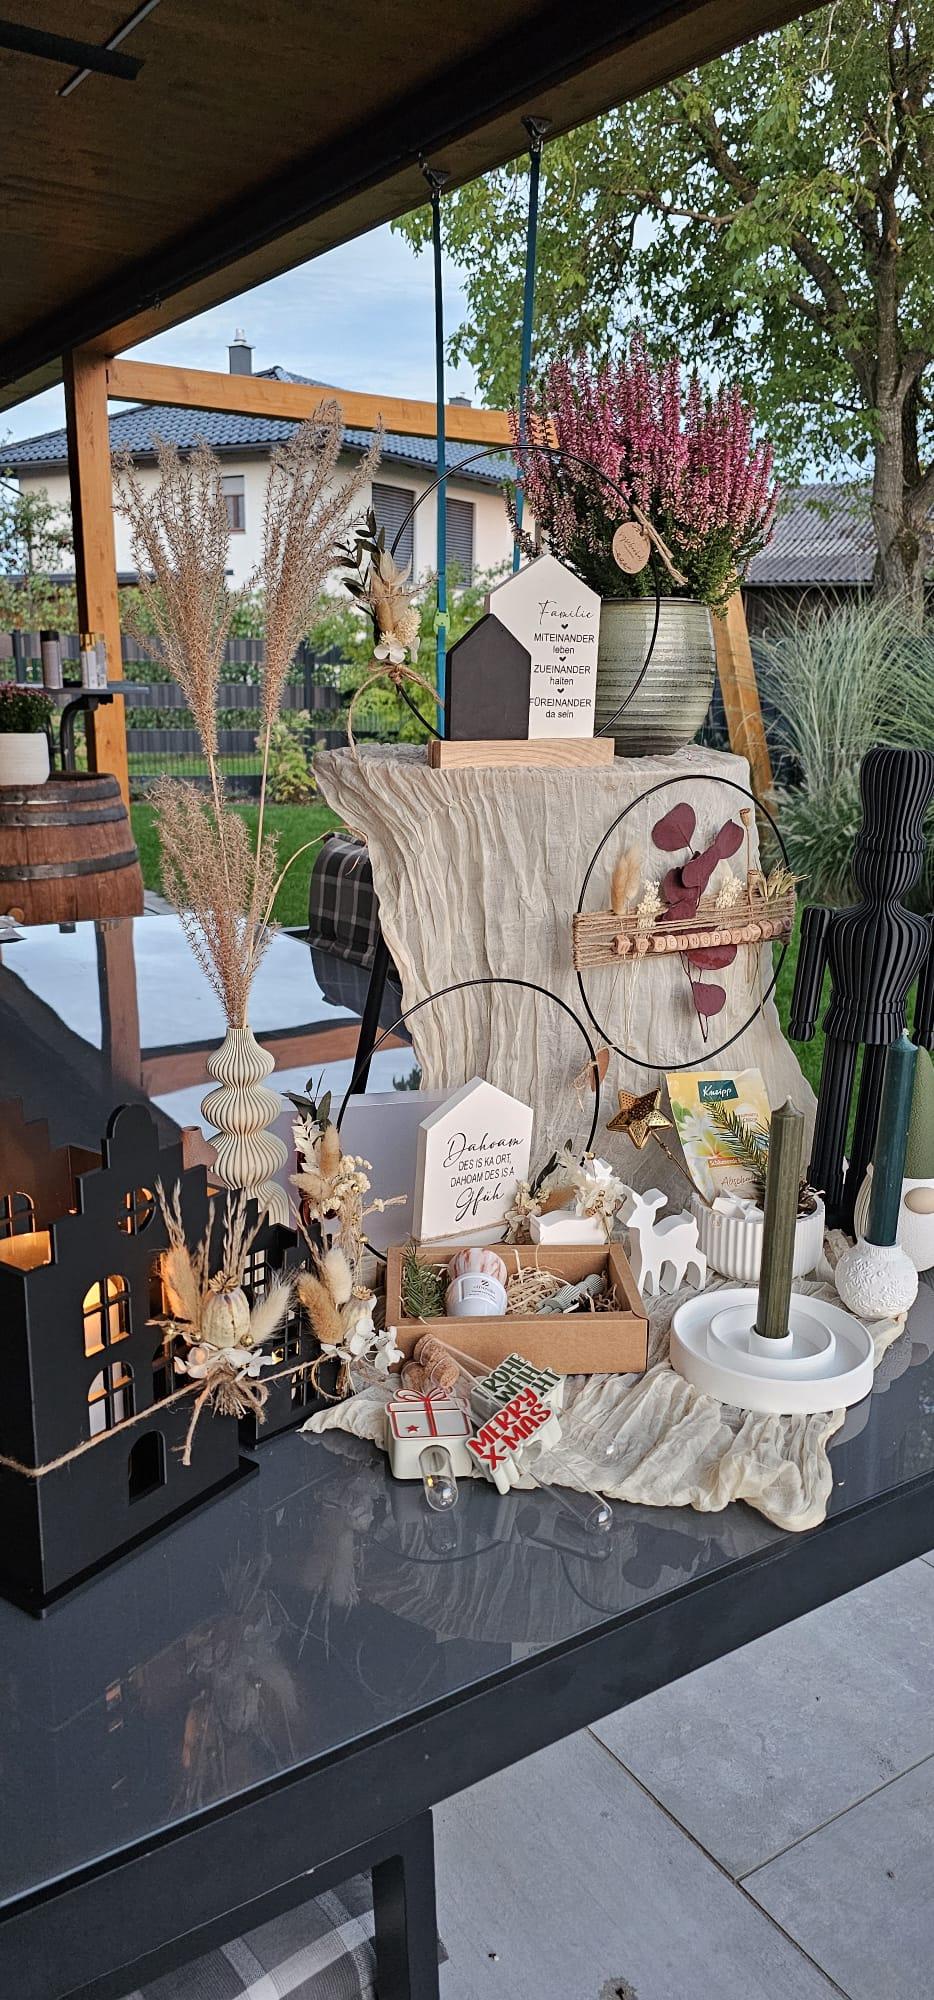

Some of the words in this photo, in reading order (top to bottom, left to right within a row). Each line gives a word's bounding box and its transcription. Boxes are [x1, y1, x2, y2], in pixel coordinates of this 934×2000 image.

[538, 600, 594, 625] Familie
[534, 633, 595, 643] MITEINANDER
[552, 645, 575, 654] leben
[533, 664, 591, 674] ZUEINANDER
[550, 676, 574, 686] halten
[529, 696, 592, 707] FÜREINANDER
[545, 710, 556, 718] da
[557, 710, 574, 719] sein
[702, 1085, 732, 1098] Kneipp
[443, 1132, 524, 1168] Dahoam
[458, 1159, 474, 1171] DES
[475, 1157, 483, 1168] IS
[484, 1156, 494, 1167] KA
[495, 1153, 512, 1165] ORT,
[450, 1172, 483, 1188] DAHOAM
[485, 1169, 500, 1181] DES
[501, 1167, 508, 1177] IS
[509, 1166, 515, 1177] A
[455, 1183, 504, 1222] Gfüh
[468, 1387, 538, 1456] MERRY
[480, 1403, 552, 1471] X-MAS
